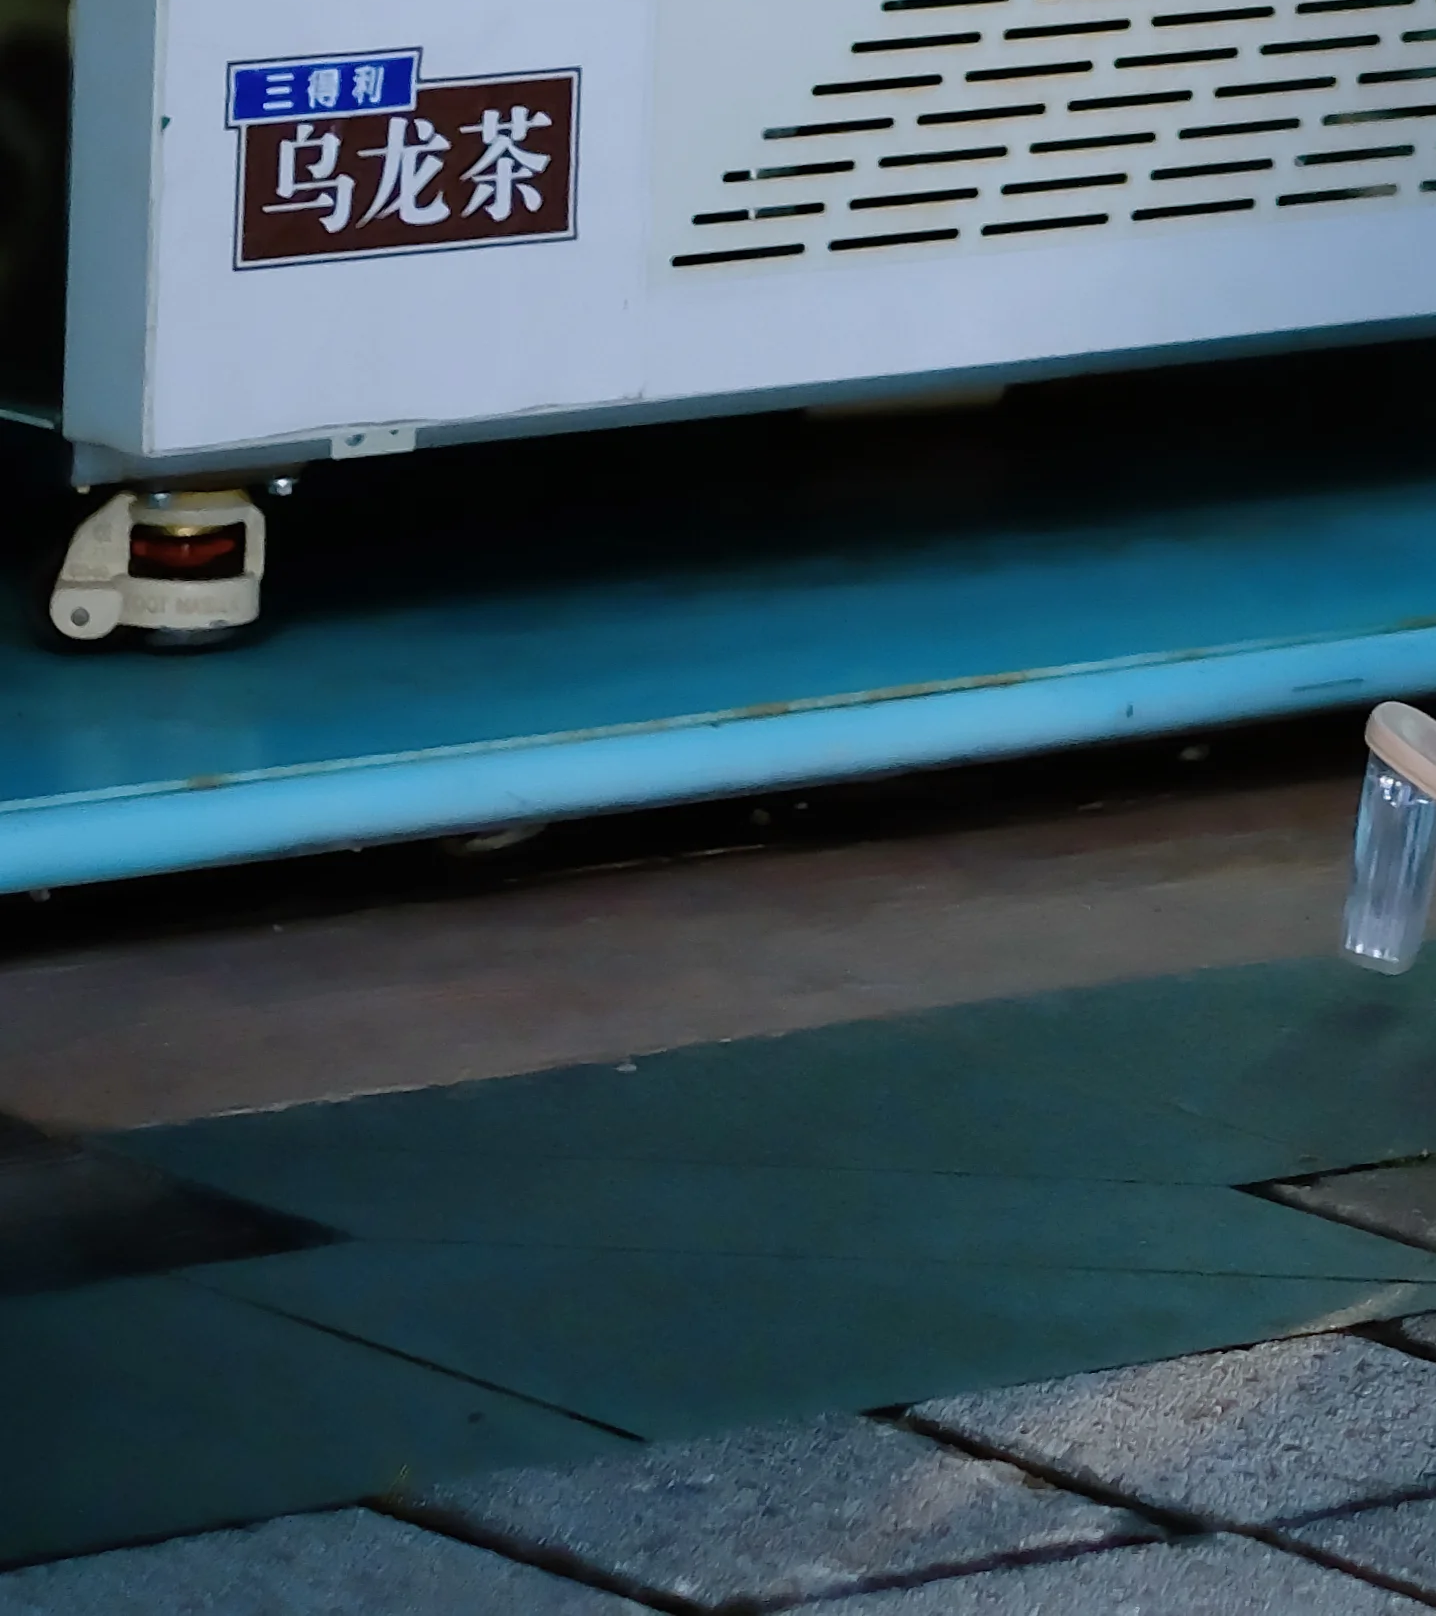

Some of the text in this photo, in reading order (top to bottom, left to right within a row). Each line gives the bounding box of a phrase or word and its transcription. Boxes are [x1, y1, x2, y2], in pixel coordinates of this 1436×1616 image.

[262, 65, 384, 111] 三得利
[262, 107, 553, 234] 乌龙茶
